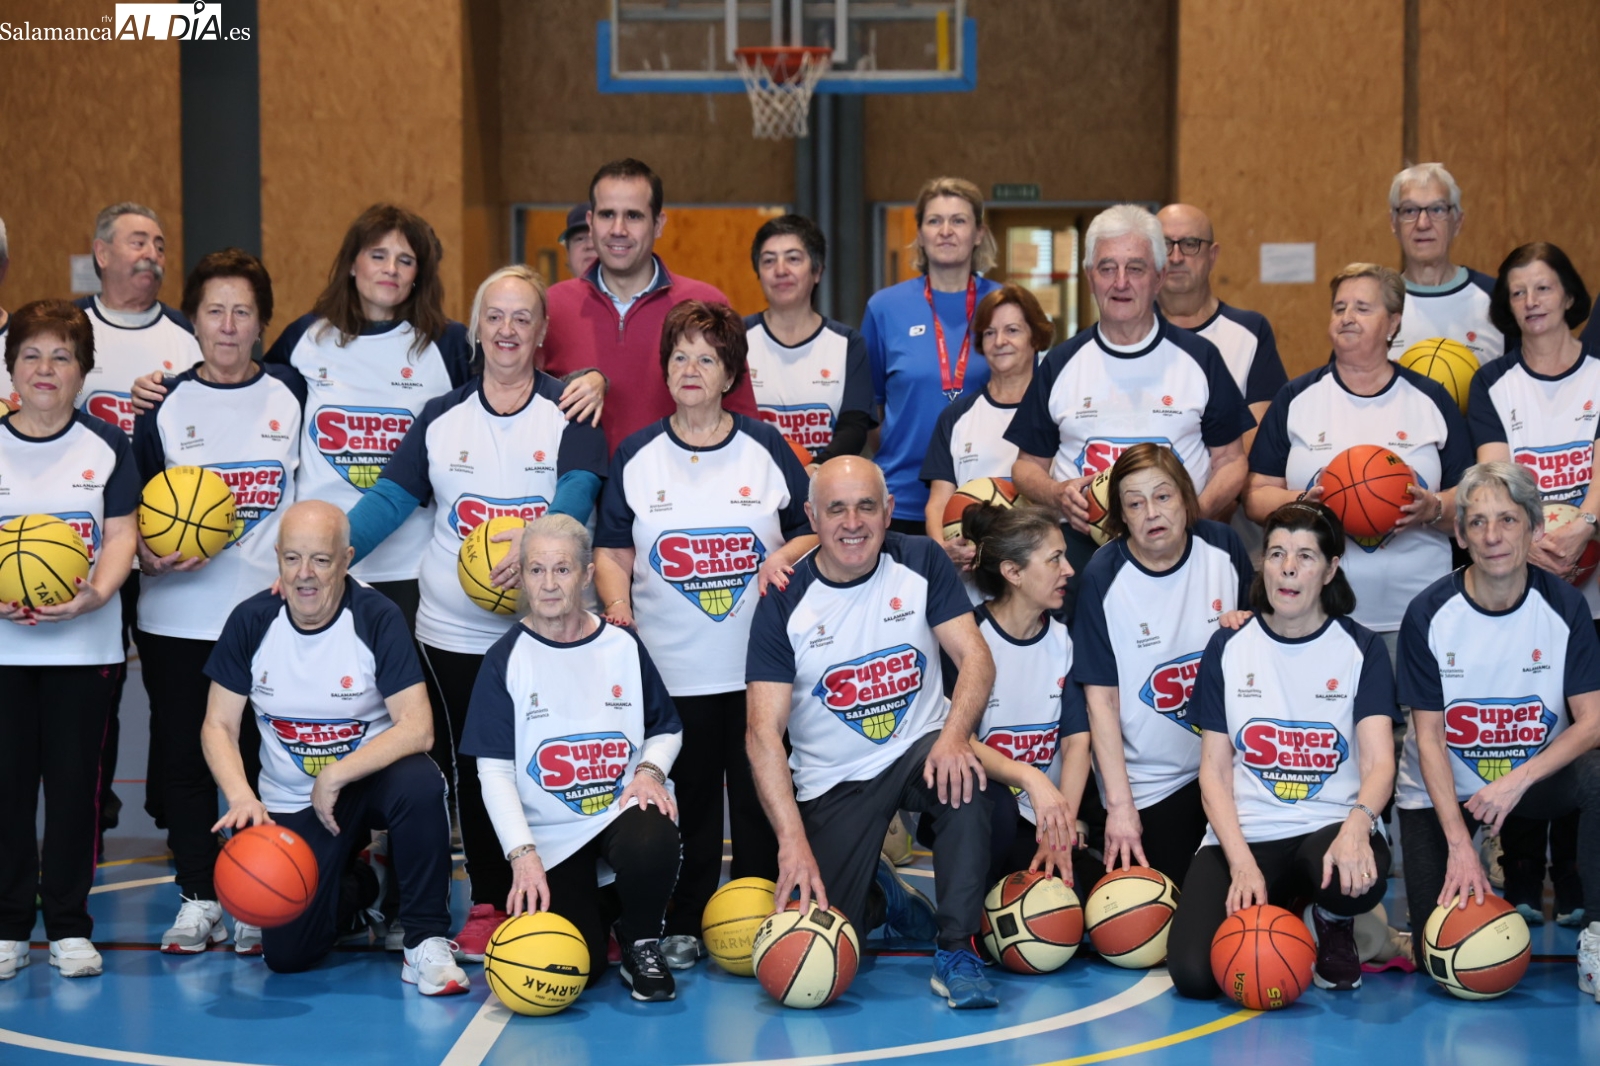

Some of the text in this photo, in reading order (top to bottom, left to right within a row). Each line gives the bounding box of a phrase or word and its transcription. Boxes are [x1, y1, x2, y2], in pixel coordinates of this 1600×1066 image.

[317, 411, 411, 437] Super
[335, 456, 391, 464] SALAMANC
[659, 536, 752, 560] Super
[659, 553, 757, 578] Senior
[684, 578, 744, 591] SALAMANCA
[825, 653, 915, 688] Super
[827, 671, 920, 708] Senior
[846, 699, 907, 720] SALAMANCA
[1446, 705, 1541, 729] Super
[1244, 725, 1334, 751] Super
[1446, 724, 1546, 745] Senior
[289, 745, 350, 755] SALAMANCA
[539, 742, 627, 766] Super
[1244, 749, 1338, 768] Senior
[1464, 750, 1526, 758] SALAMANCA
[1262, 771, 1321, 782] SALAMANCA
[712, 936, 753, 951] TARM
[522, 975, 581, 997] TARMAK
